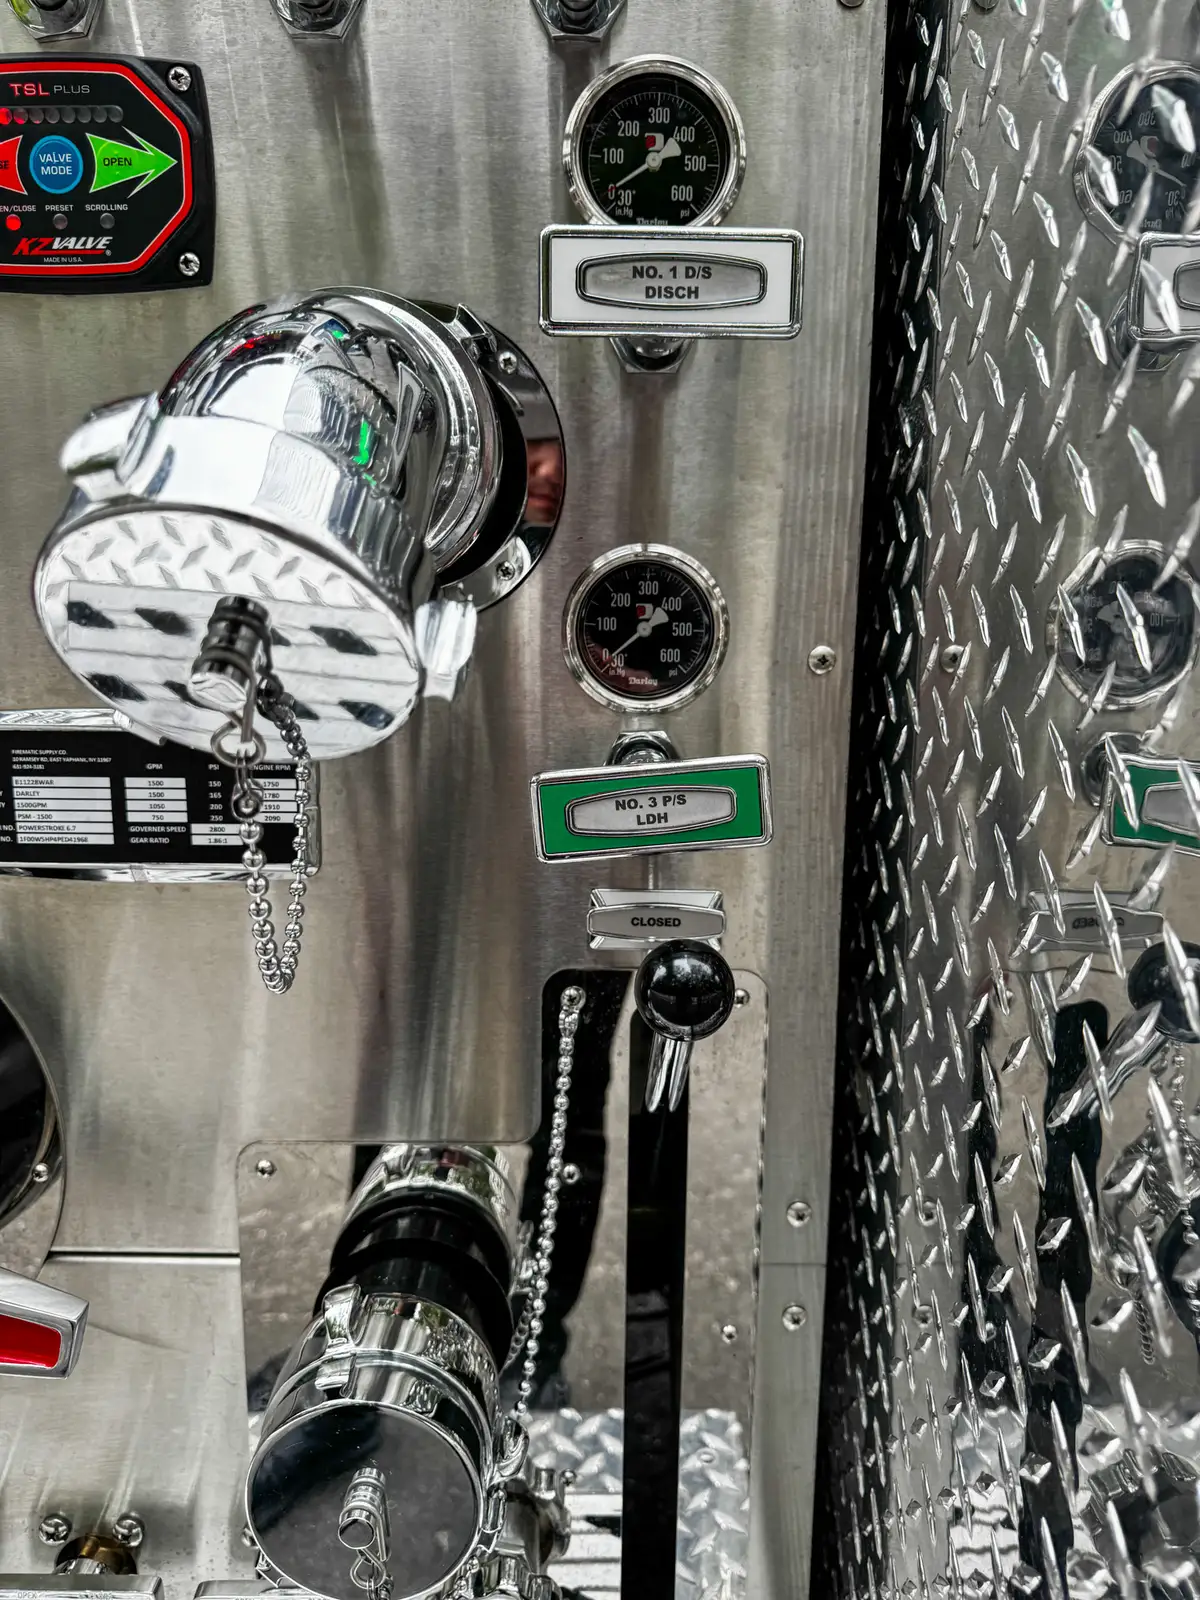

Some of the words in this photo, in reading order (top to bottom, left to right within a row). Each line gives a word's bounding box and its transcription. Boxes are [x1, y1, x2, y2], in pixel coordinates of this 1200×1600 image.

[9, 83, 50, 97] TSL
[54, 84, 90, 94] PLUS
[648, 107, 670, 123] 300
[617, 121, 640, 137] 200
[673, 126, 695, 142] 400
[39, 152, 72, 163] VALVE
[103, 157, 132, 167] OPEN
[603, 148, 624, 164] 100
[41, 165, 73, 175] MODE
[684, 155, 706, 172] 500
[671, 185, 693, 201] 600
[0, 204, 36, 212] EN/CLOSE
[680, 208, 690, 218] psi
[632, 265, 662, 280] NO.
[669, 265, 678, 279] 1
[685, 265, 712, 280] D/S
[645, 286, 699, 299] DISCH
[638, 581, 659, 595] 300
[610, 593, 631, 607] 200
[661, 597, 682, 611] 400
[597, 616, 617, 631] 100
[672, 622, 692, 637] 500
[660, 648, 680, 662] 600
[669, 668, 678, 678] psi
[628, 677, 658, 686] Darley
[615, 798, 643, 811] NO.
[648, 796, 657, 808] 3
[662, 794, 687, 806] P/S
[636, 812, 669, 825] LDH
[631, 917, 682, 928] CLOSED
